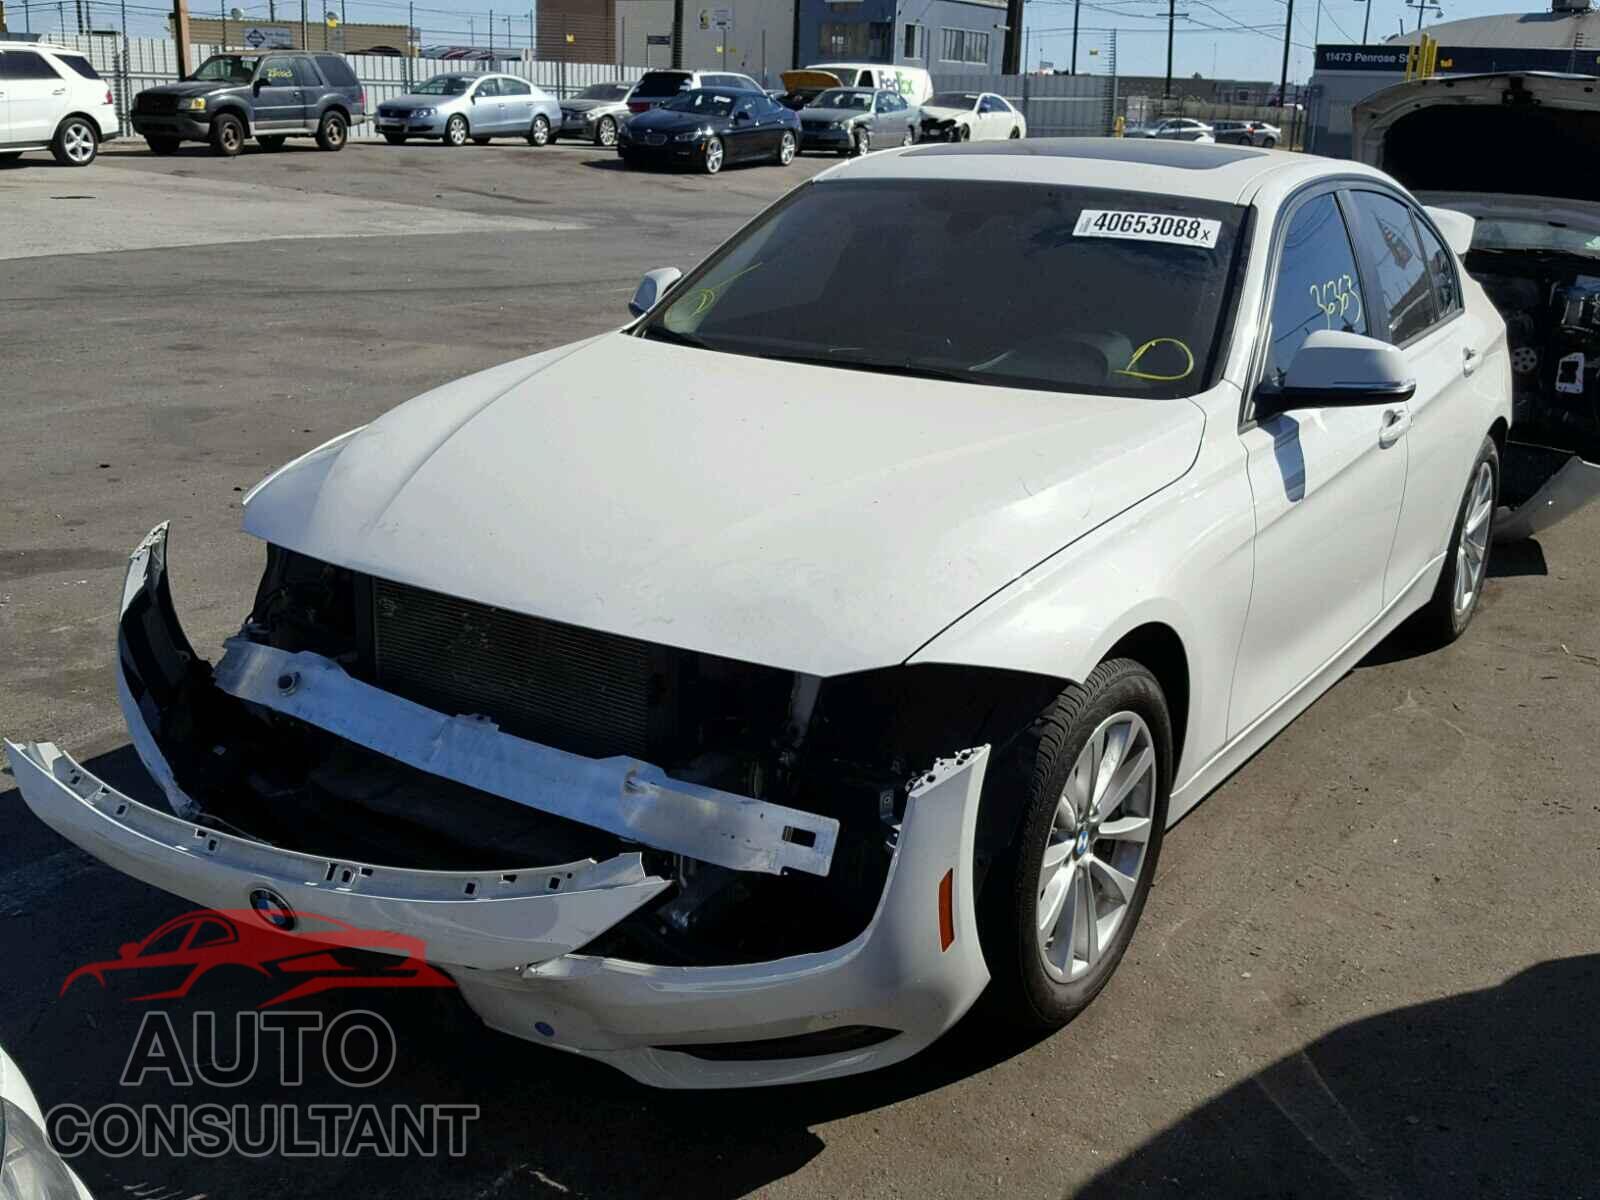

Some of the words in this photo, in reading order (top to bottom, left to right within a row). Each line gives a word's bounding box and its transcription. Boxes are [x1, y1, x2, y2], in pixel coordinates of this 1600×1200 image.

[1325, 52, 1352, 62] 11473
[1355, 53, 1395, 63] Penrose
[1093, 212, 1200, 240] 40653088
